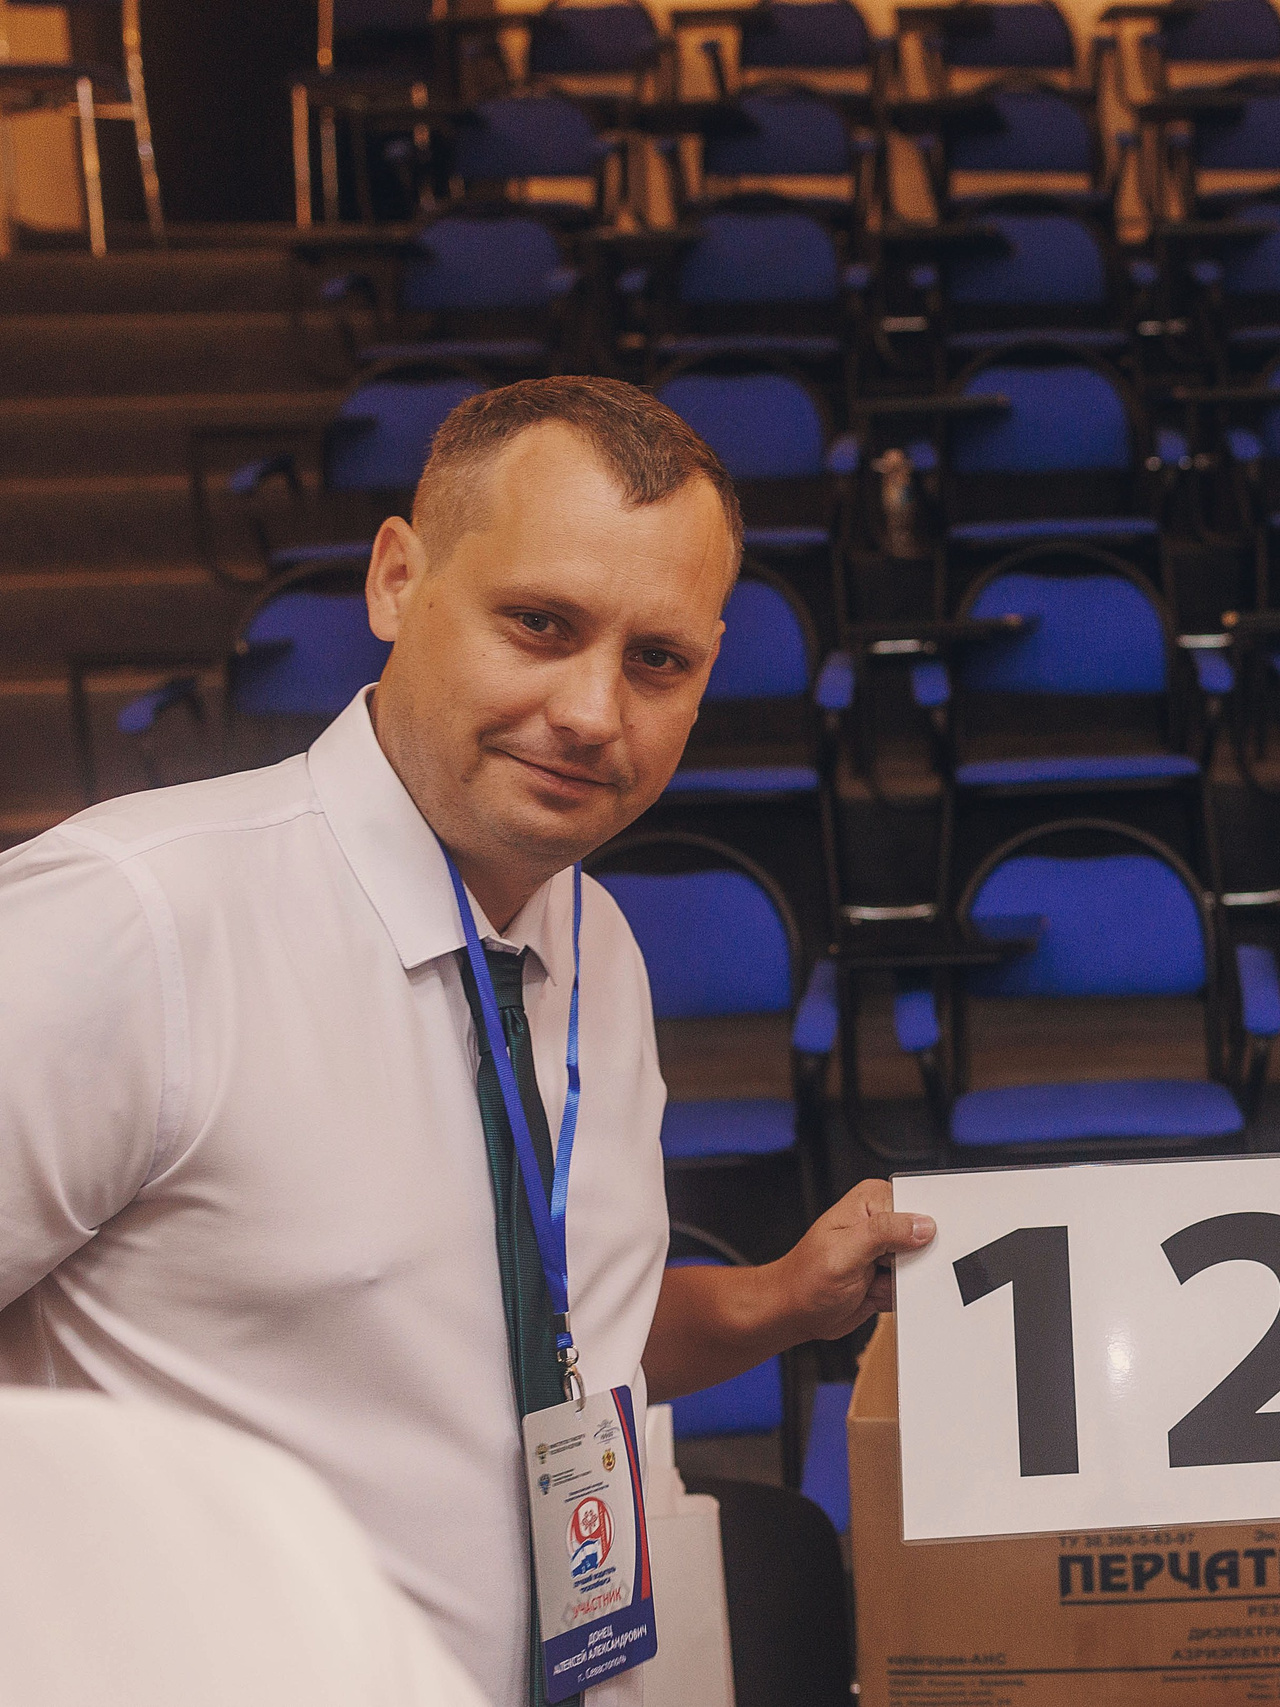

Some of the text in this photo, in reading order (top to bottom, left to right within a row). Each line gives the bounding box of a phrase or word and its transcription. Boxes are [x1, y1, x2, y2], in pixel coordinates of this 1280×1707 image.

[572, 1587, 621, 1619] УЧАСТНИК
[553, 1623, 647, 1676] АЛЕКСЕЙ АЛЕКСАНДРОВИЧ
[587, 1624, 613, 1648] ДОНЕЦ
[585, 1654, 627, 1680] Севастополь
